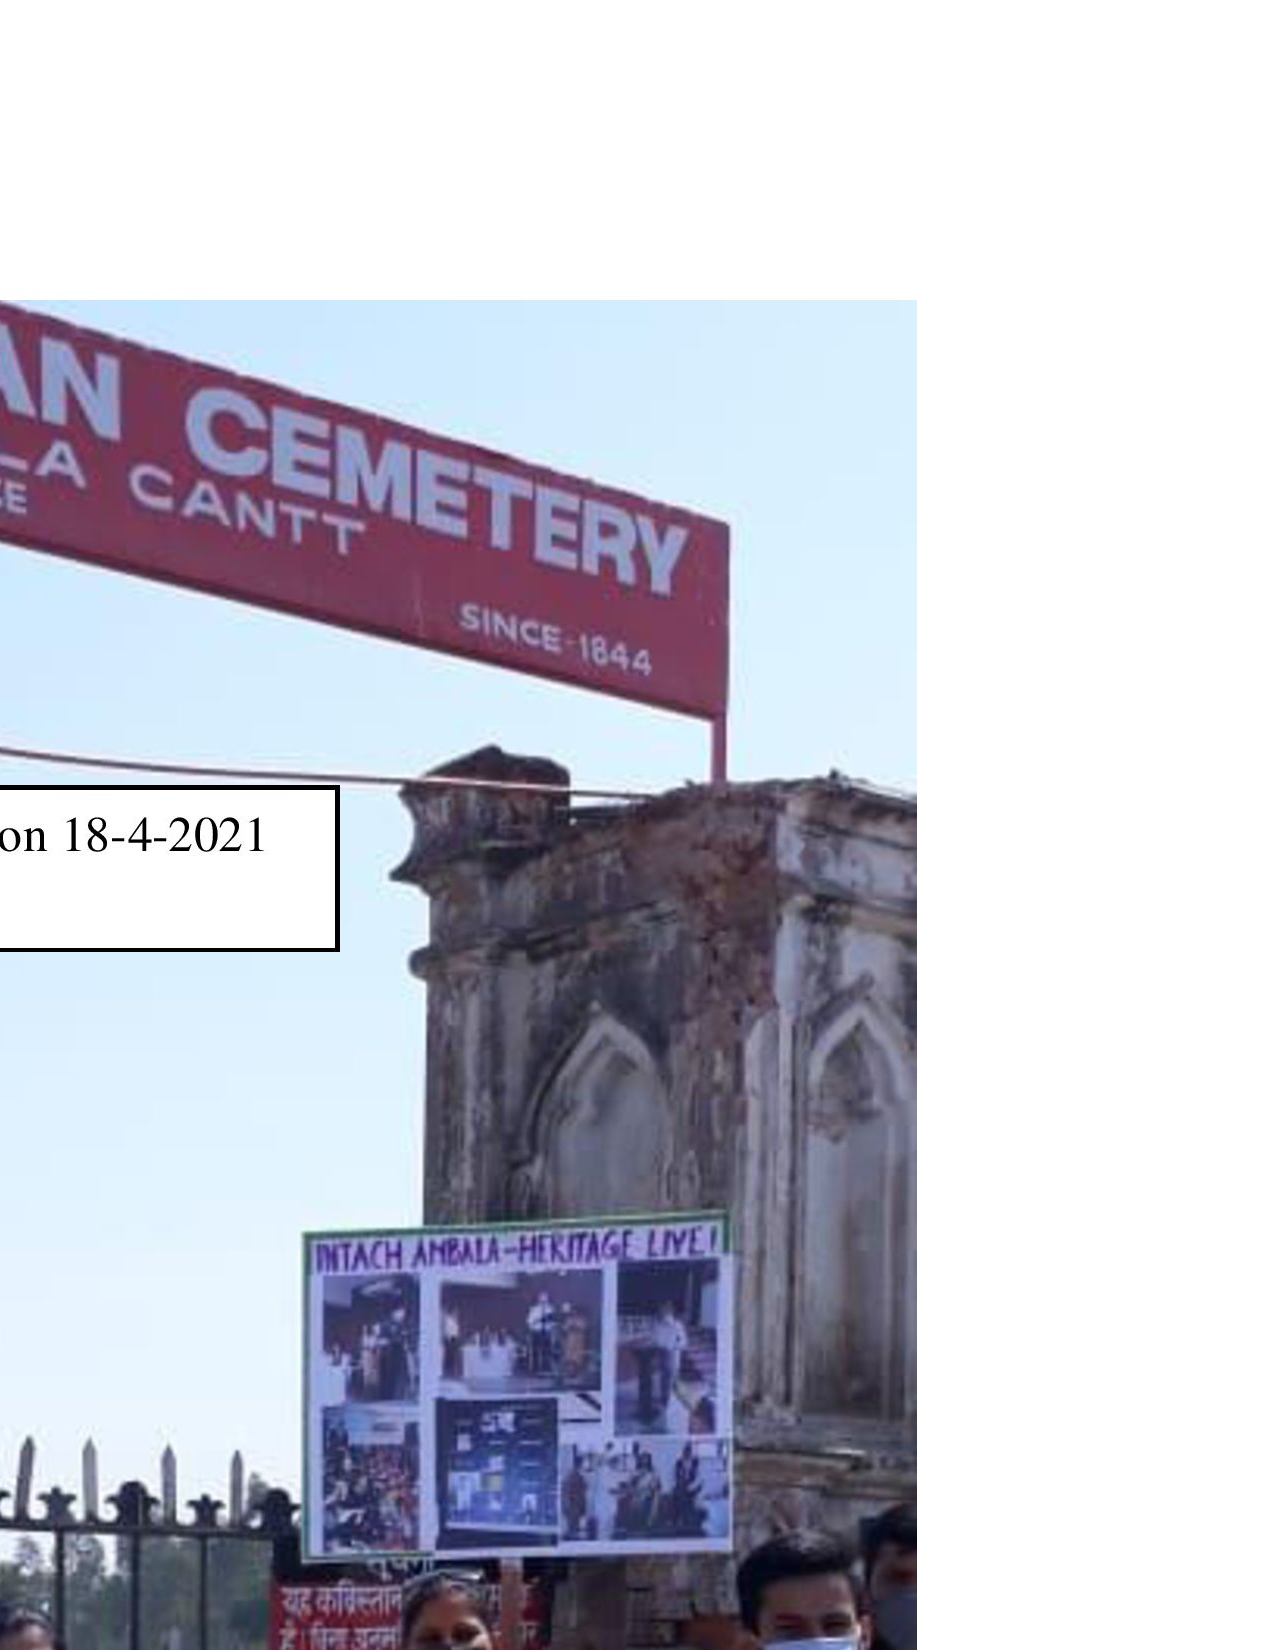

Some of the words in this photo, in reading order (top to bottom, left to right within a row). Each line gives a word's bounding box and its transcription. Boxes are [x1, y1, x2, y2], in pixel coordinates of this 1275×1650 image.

[128, 462, 367, 557] CANTT
[184, 387, 689, 597] CEMETERY
[314, 1238, 403, 1273] INTACH
